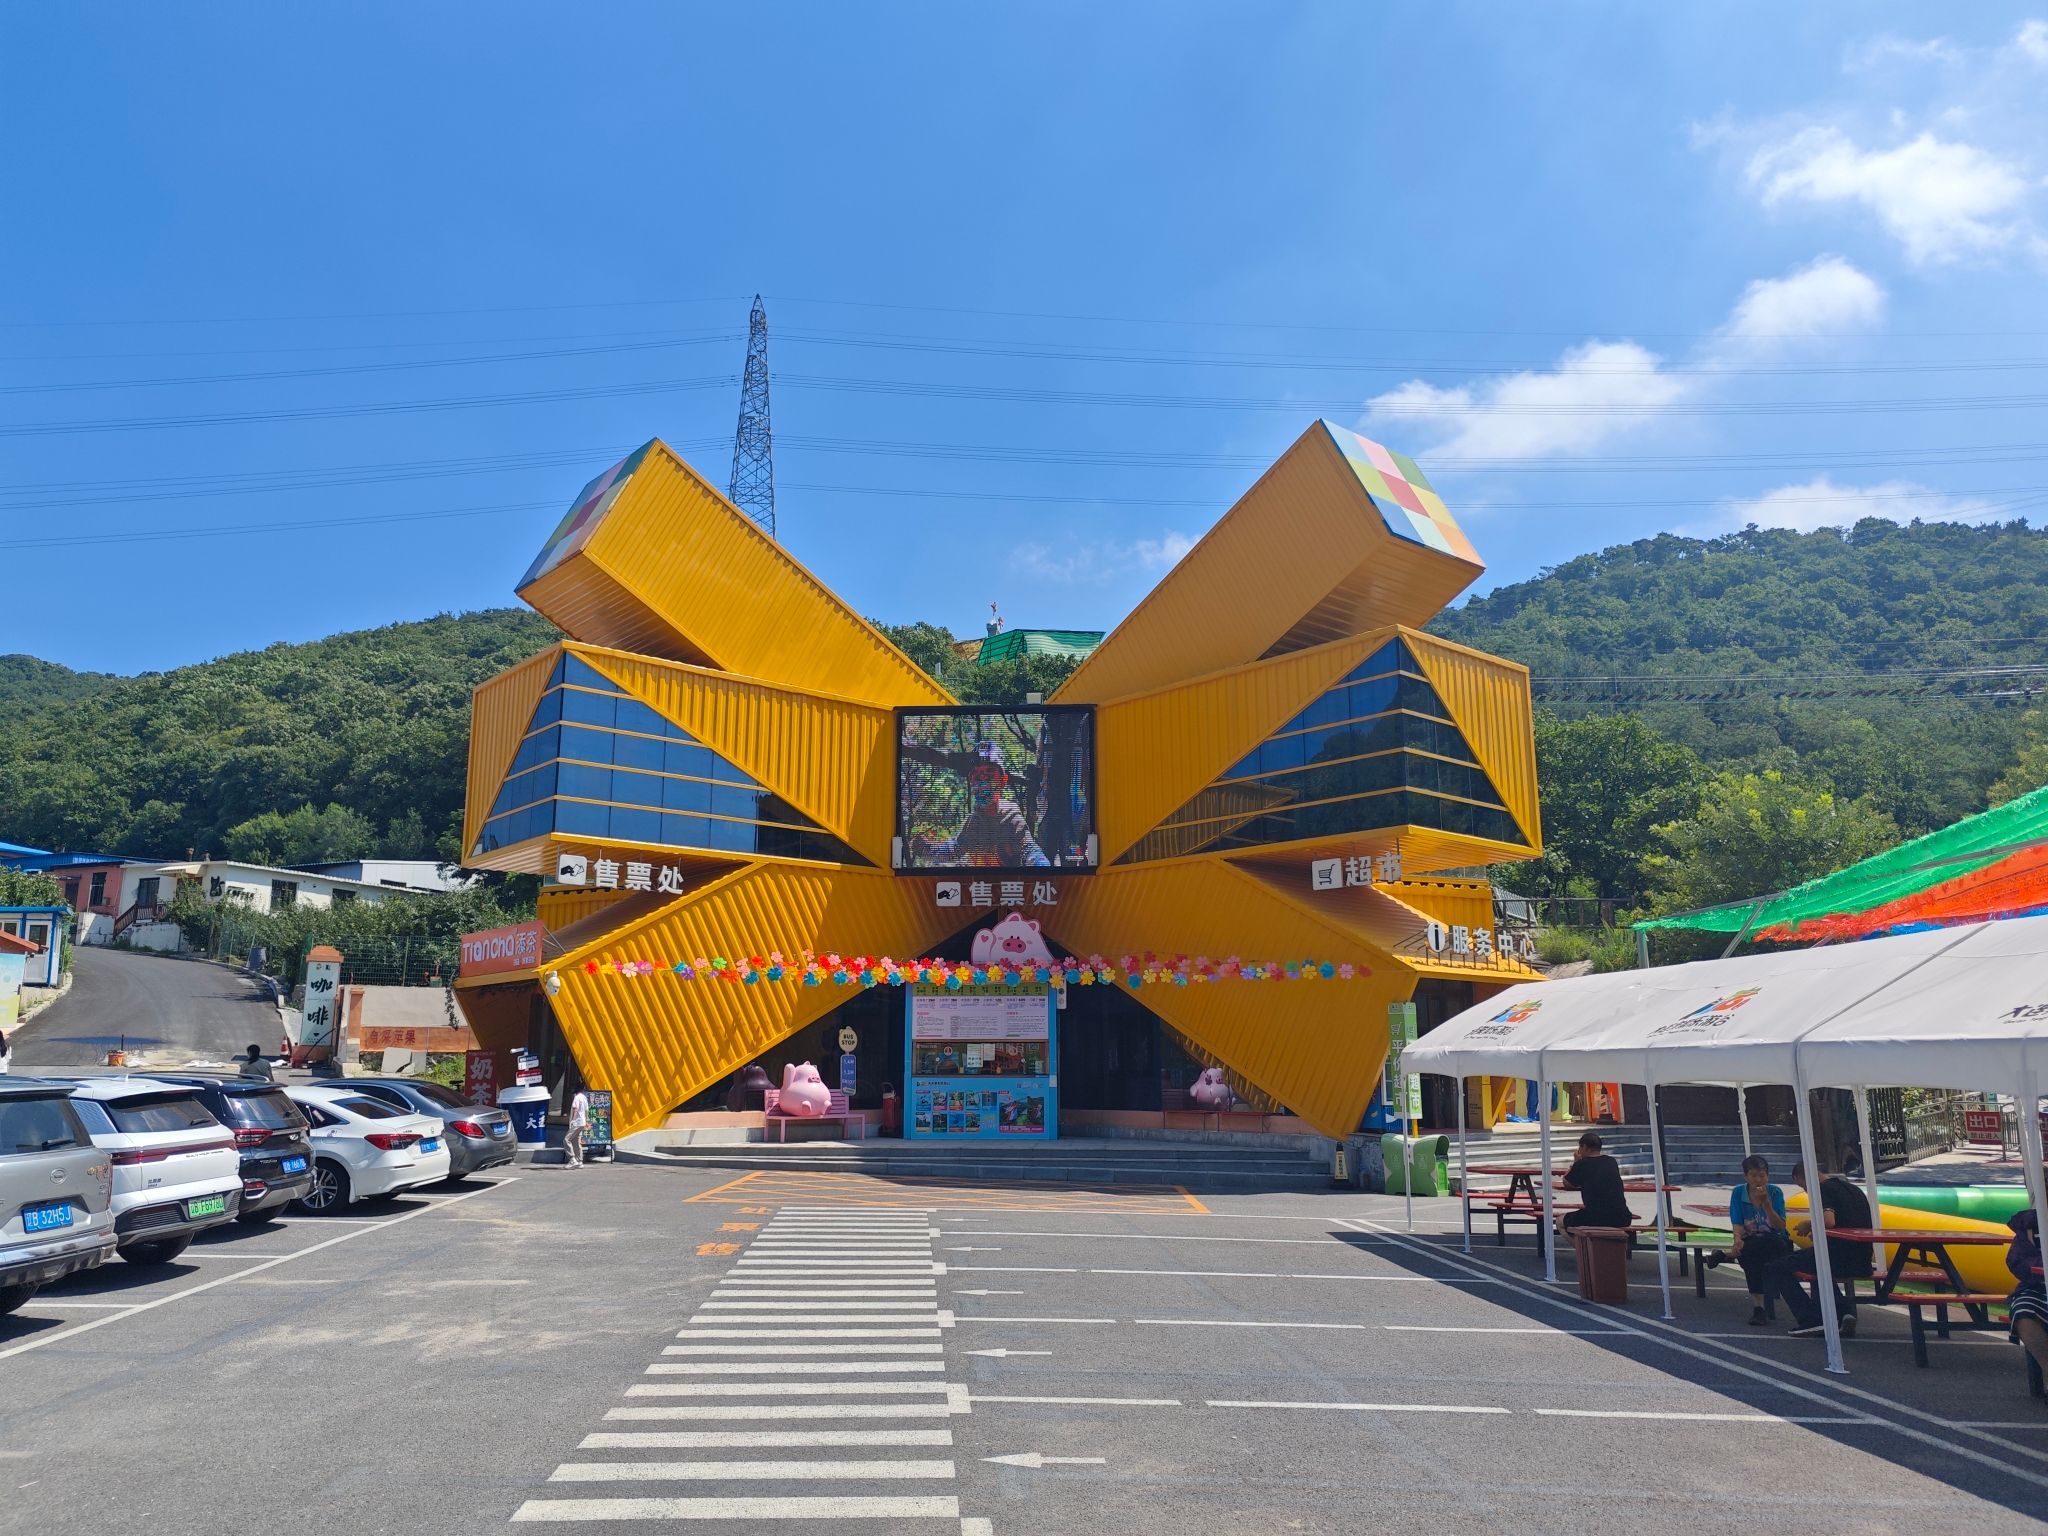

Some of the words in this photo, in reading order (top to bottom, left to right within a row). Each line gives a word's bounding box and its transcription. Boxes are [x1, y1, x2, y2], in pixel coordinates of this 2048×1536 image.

[593, 859, 684, 895] 售票处
[1345, 851, 1402, 887] 超市
[969, 881, 1058, 906] 售票处
[1453, 926, 1537, 960] 服务中心
[307, 977, 333, 1026] 咖啡
[470, 1056, 493, 1106] 奶茶
[1969, 1115, 1998, 1129] 出口
